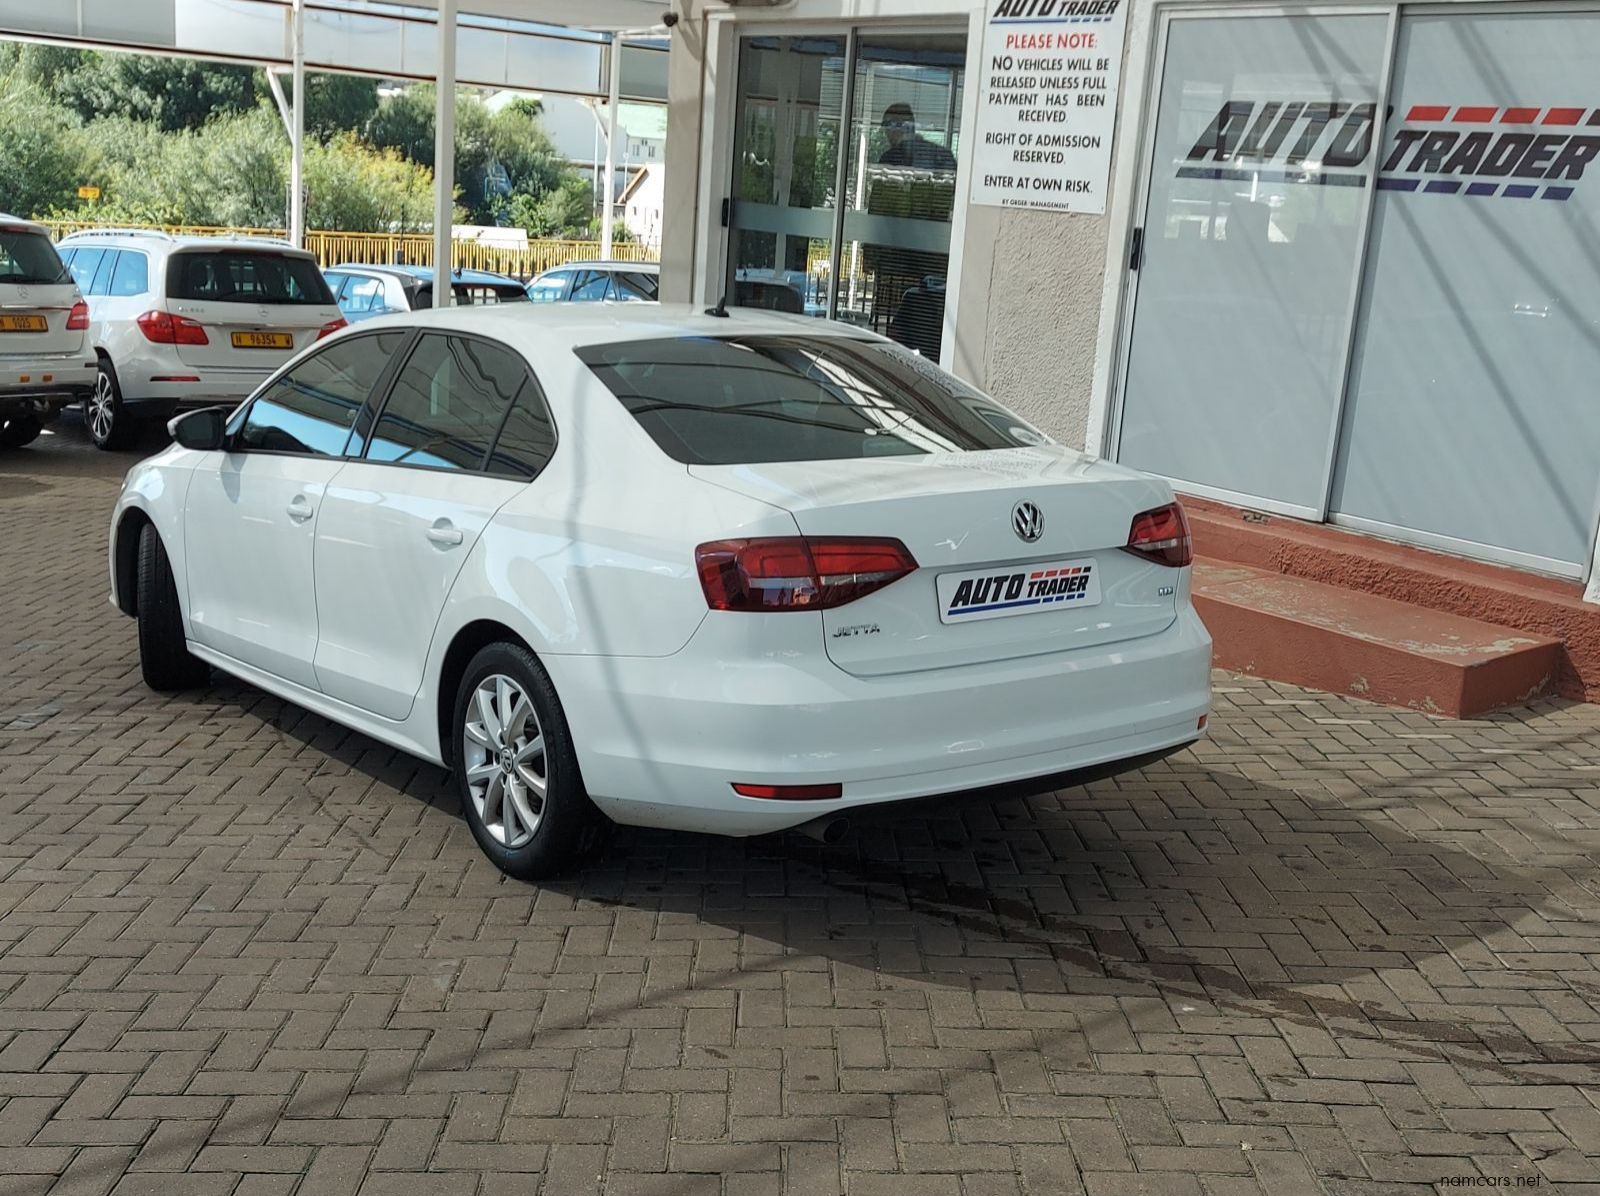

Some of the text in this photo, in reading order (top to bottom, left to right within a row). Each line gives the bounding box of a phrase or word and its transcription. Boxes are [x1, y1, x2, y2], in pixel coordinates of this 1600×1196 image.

[993, 0, 1120, 17] AUTO TRADER
[1006, 32, 1098, 49] PLEASE NOTE:
[992, 56, 1110, 71] NO VEHICLES WILL BE
[990, 76, 1107, 90] RELEASED UNLESS FULL
[988, 93, 1106, 107] PAYMENT HAS BEEN
[1018, 109, 1068, 123] RECEIVED.
[985, 132, 1101, 149] RIGHT OF ADMISSION
[1186, 101, 1600, 180] AUTO TRADER
[1013, 150, 1066, 164] RESERVED.
[984, 175, 1093, 194] ENTER AT OWN RISK.
[1010, 199, 1028, 207] ORDER
[1030, 201, 1070, 210] MANAGEMENT
[950, 573, 1090, 608] AUTO TRADER
[833, 623, 881, 638] JETTA
